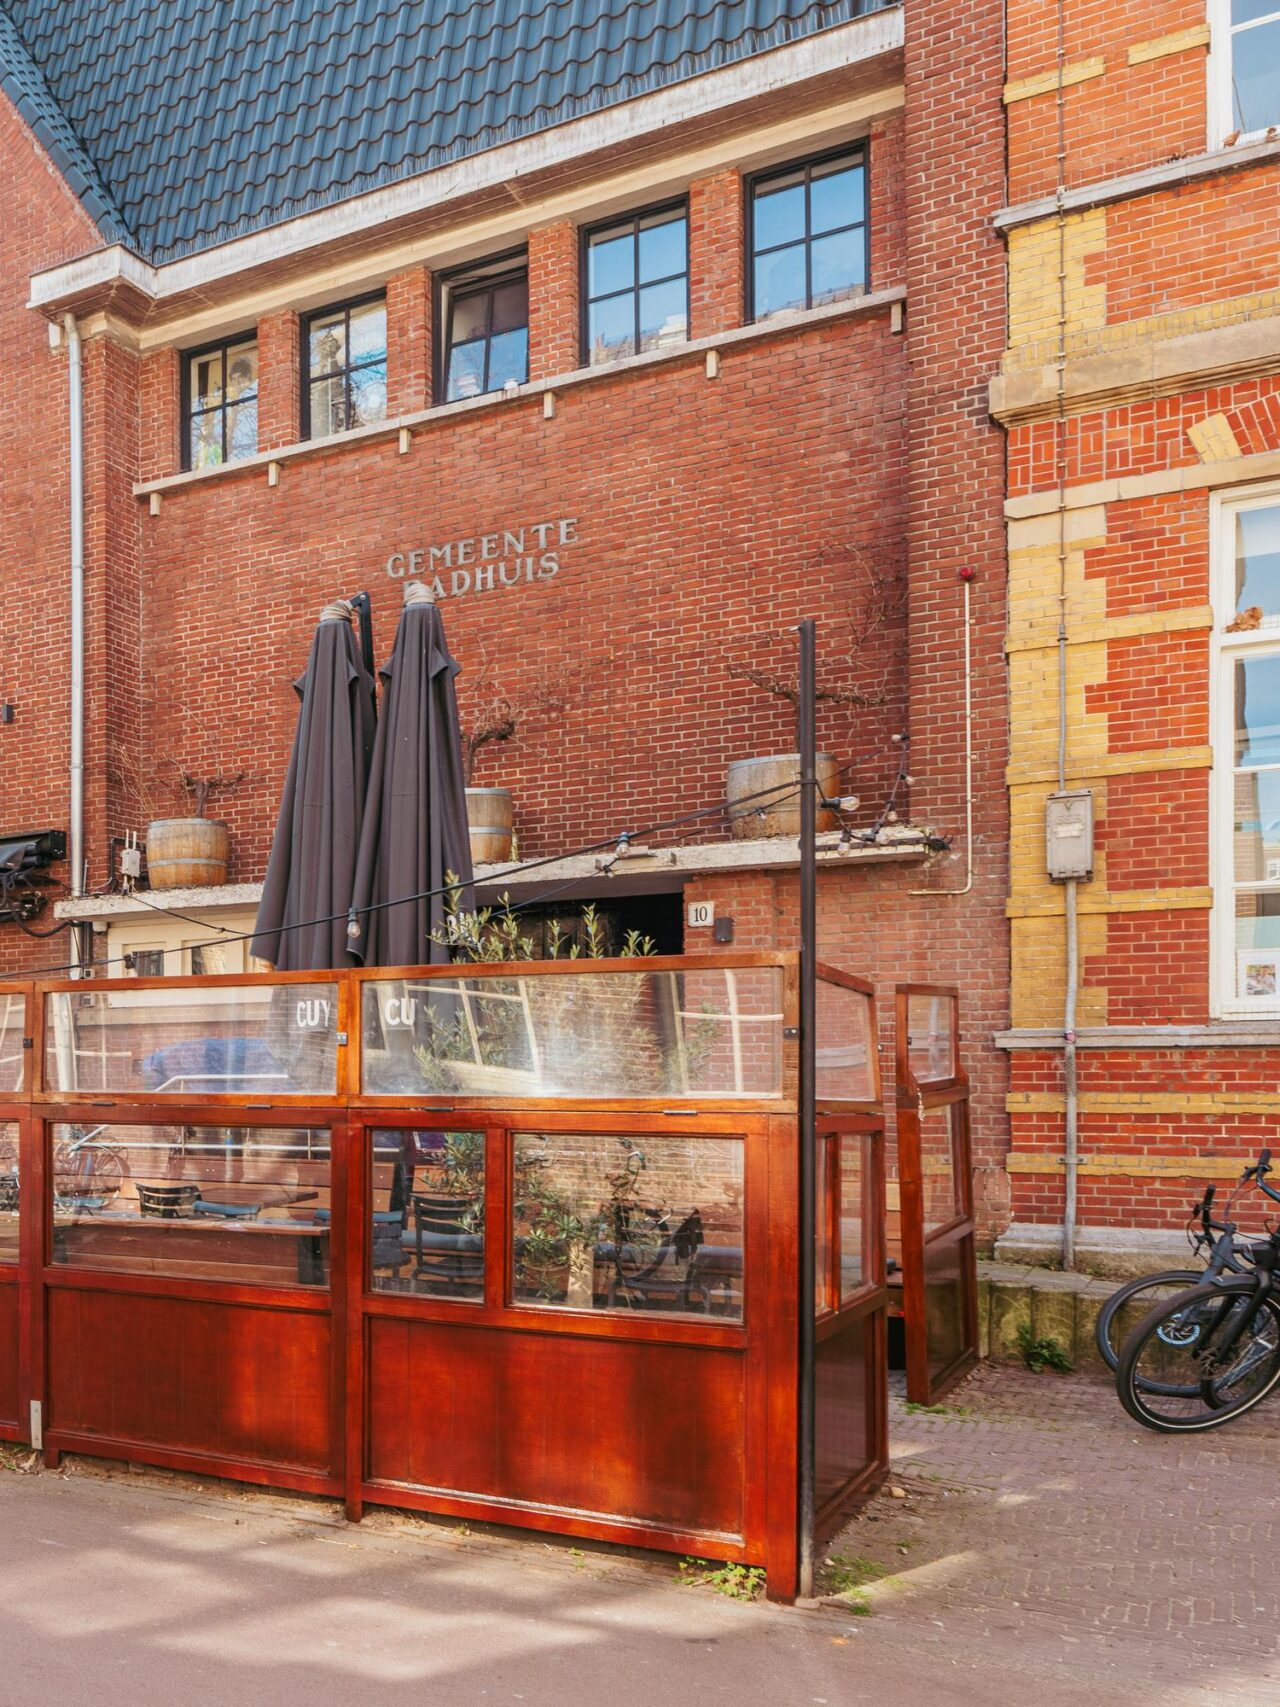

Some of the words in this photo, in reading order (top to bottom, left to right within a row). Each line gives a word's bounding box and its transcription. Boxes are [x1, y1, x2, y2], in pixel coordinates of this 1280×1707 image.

[386, 518, 579, 578] GEMEENTE
[403, 552, 560, 600] ADHUIS
[694, 906, 708, 922] 10
